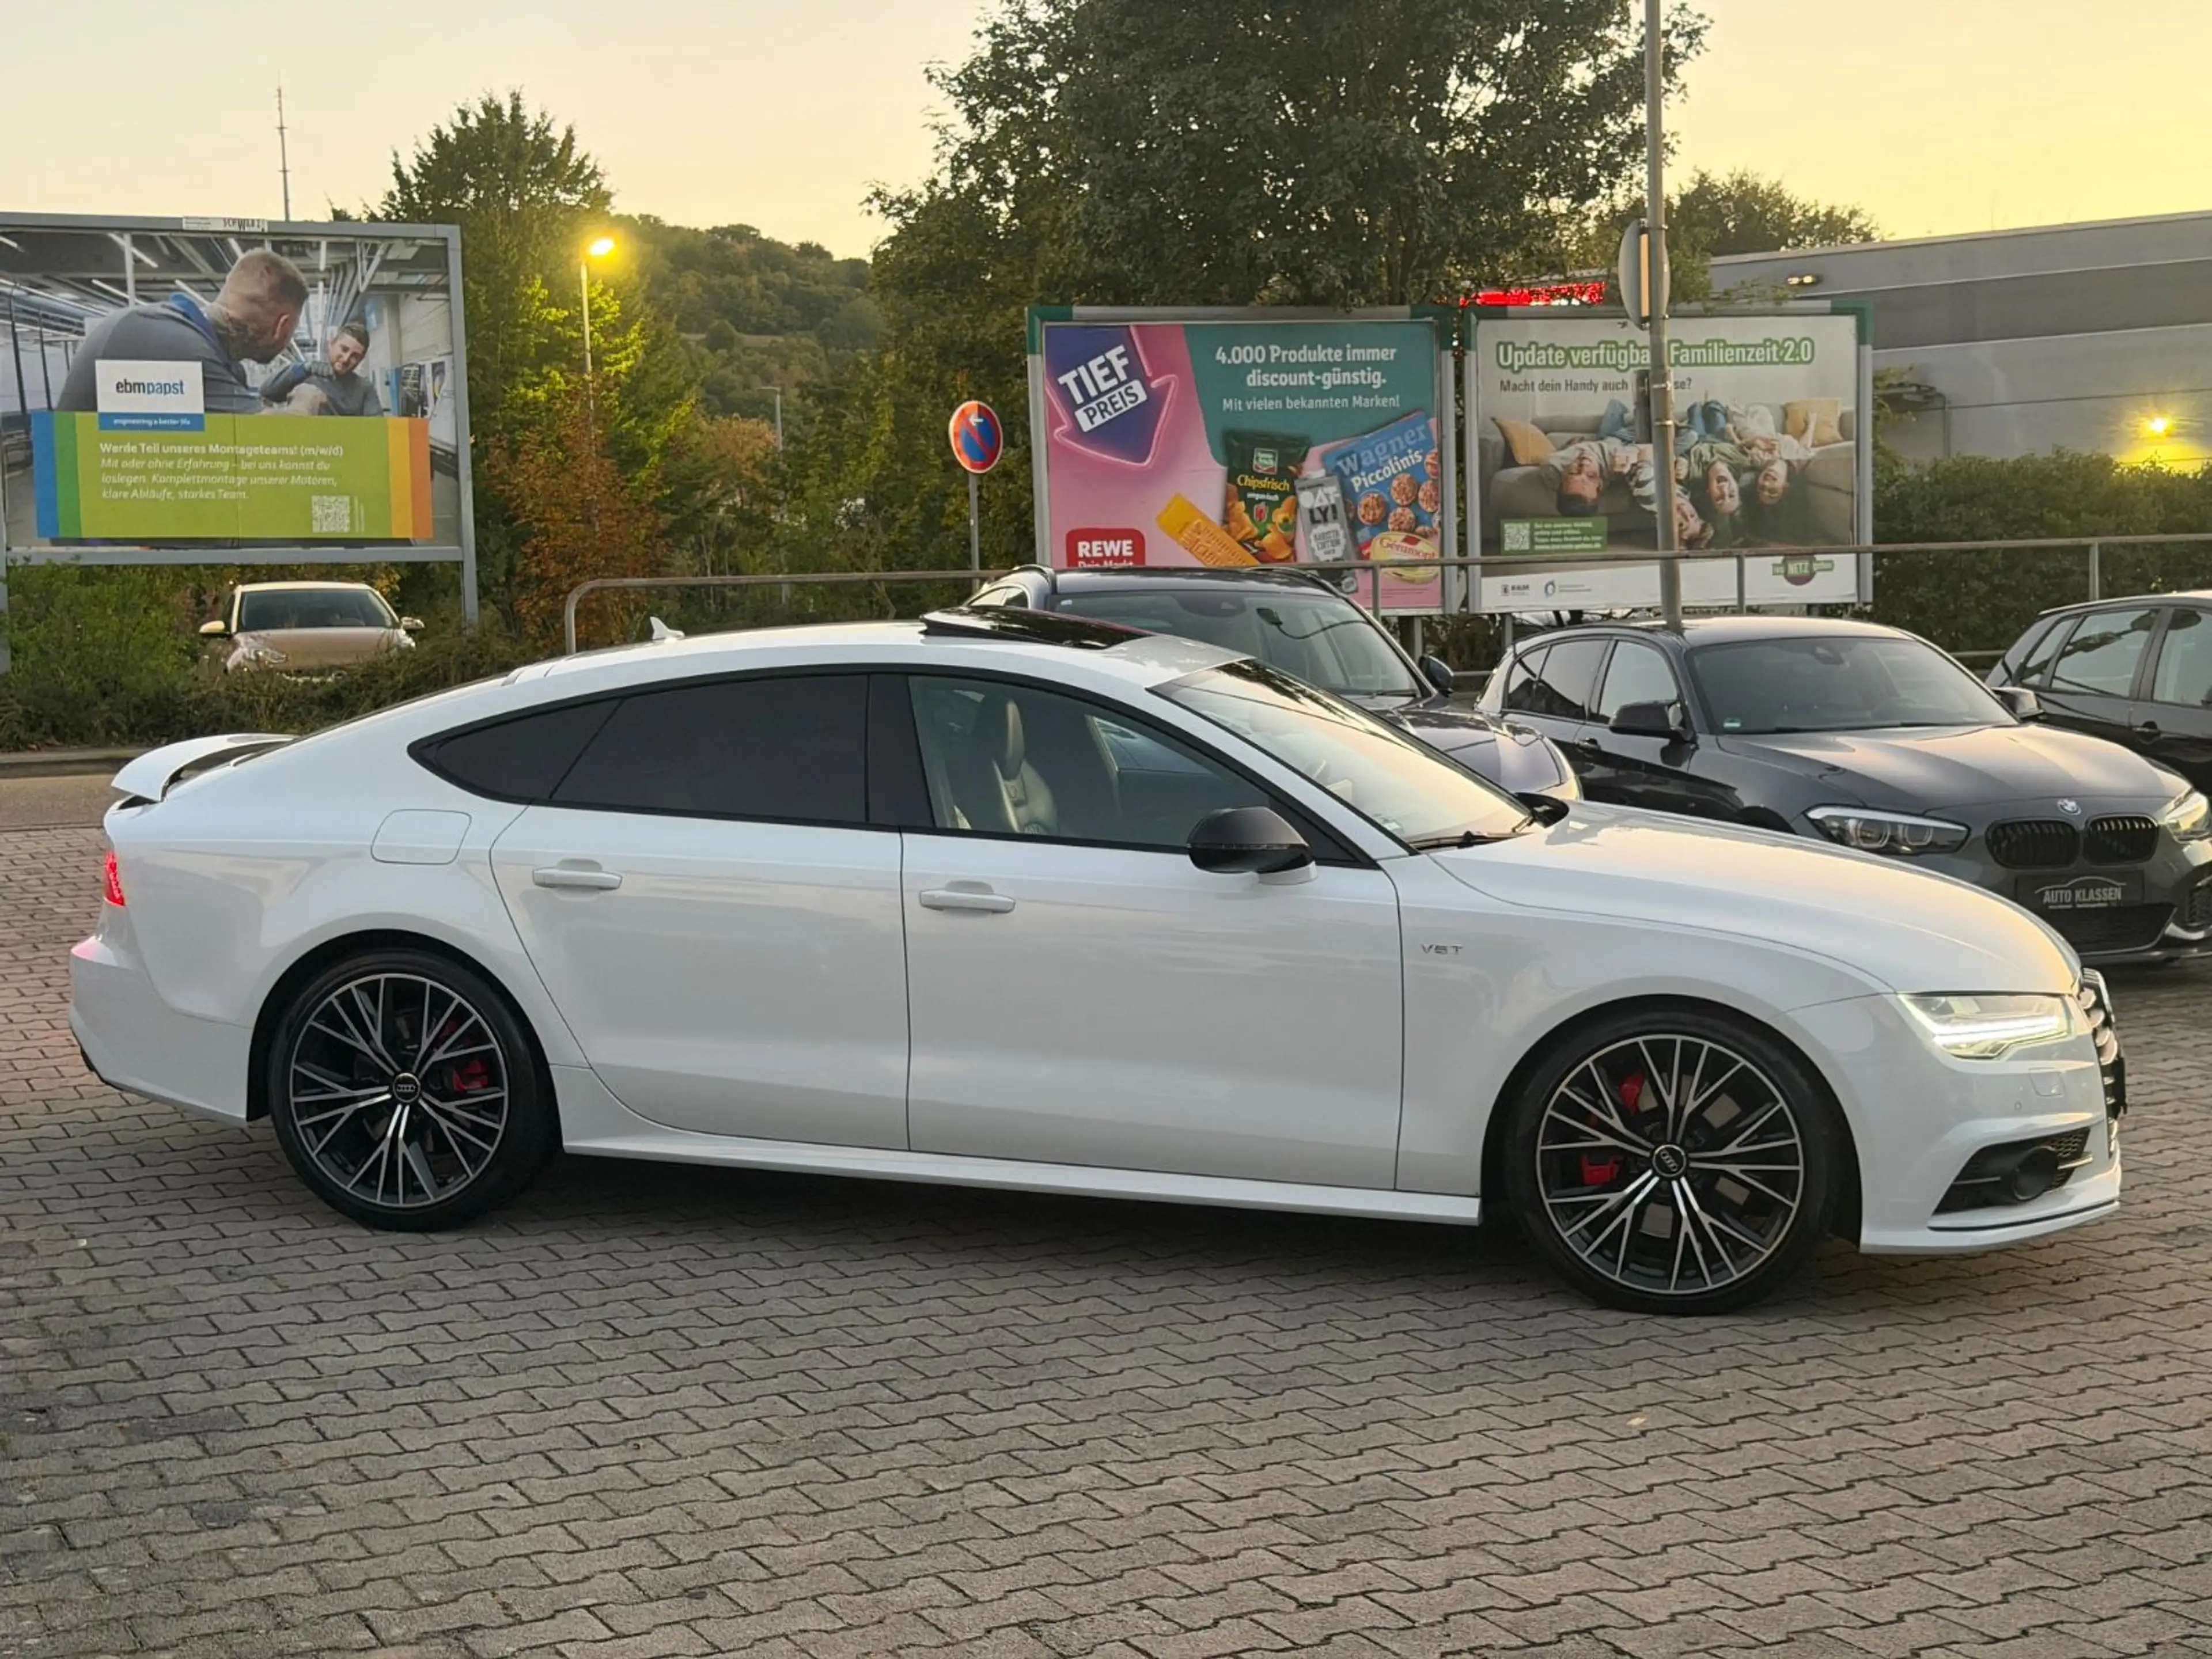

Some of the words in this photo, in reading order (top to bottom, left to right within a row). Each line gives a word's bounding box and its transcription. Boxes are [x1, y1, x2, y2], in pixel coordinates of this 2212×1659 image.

[1215, 345, 1266, 364] 4.000
[1268, 344, 1343, 363] Produkte
[1346, 343, 1397, 361] immer
[1498, 344, 1566, 372] Update
[1570, 342, 1651, 370] verfügba
[1670, 340, 1779, 364] Familienzeit
[1783, 339, 1812, 362] 2.0
[1057, 343, 1129, 405] TIEF
[1245, 367, 1387, 390] discount-günstig.
[116, 378, 185, 395] ebmpapst
[1499, 379, 1535, 392] Macht
[1537, 379, 1561, 392] dein
[1565, 379, 1599, 394] Handy
[1601, 378, 1628, 391] auch
[1082, 385, 1139, 426] PREIS
[1222, 397, 1244, 411] Mit
[1245, 396, 1283, 411] vielen
[1285, 395, 1349, 410] bekannten
[1352, 394, 1400, 409] Marken!
[100, 442, 138, 454] Werde
[139, 442, 160, 454] Teil
[162, 444, 206, 454] unseres
[300, 445, 343, 457] (m/w/d)
[1336, 424, 1427, 477] Wagner
[1350, 449, 1423, 493] Piccolinis
[1077, 539, 1134, 558] REWE
[2043, 889, 2072, 905] AUTO
[2075, 887, 2122, 902] KLASSEN
